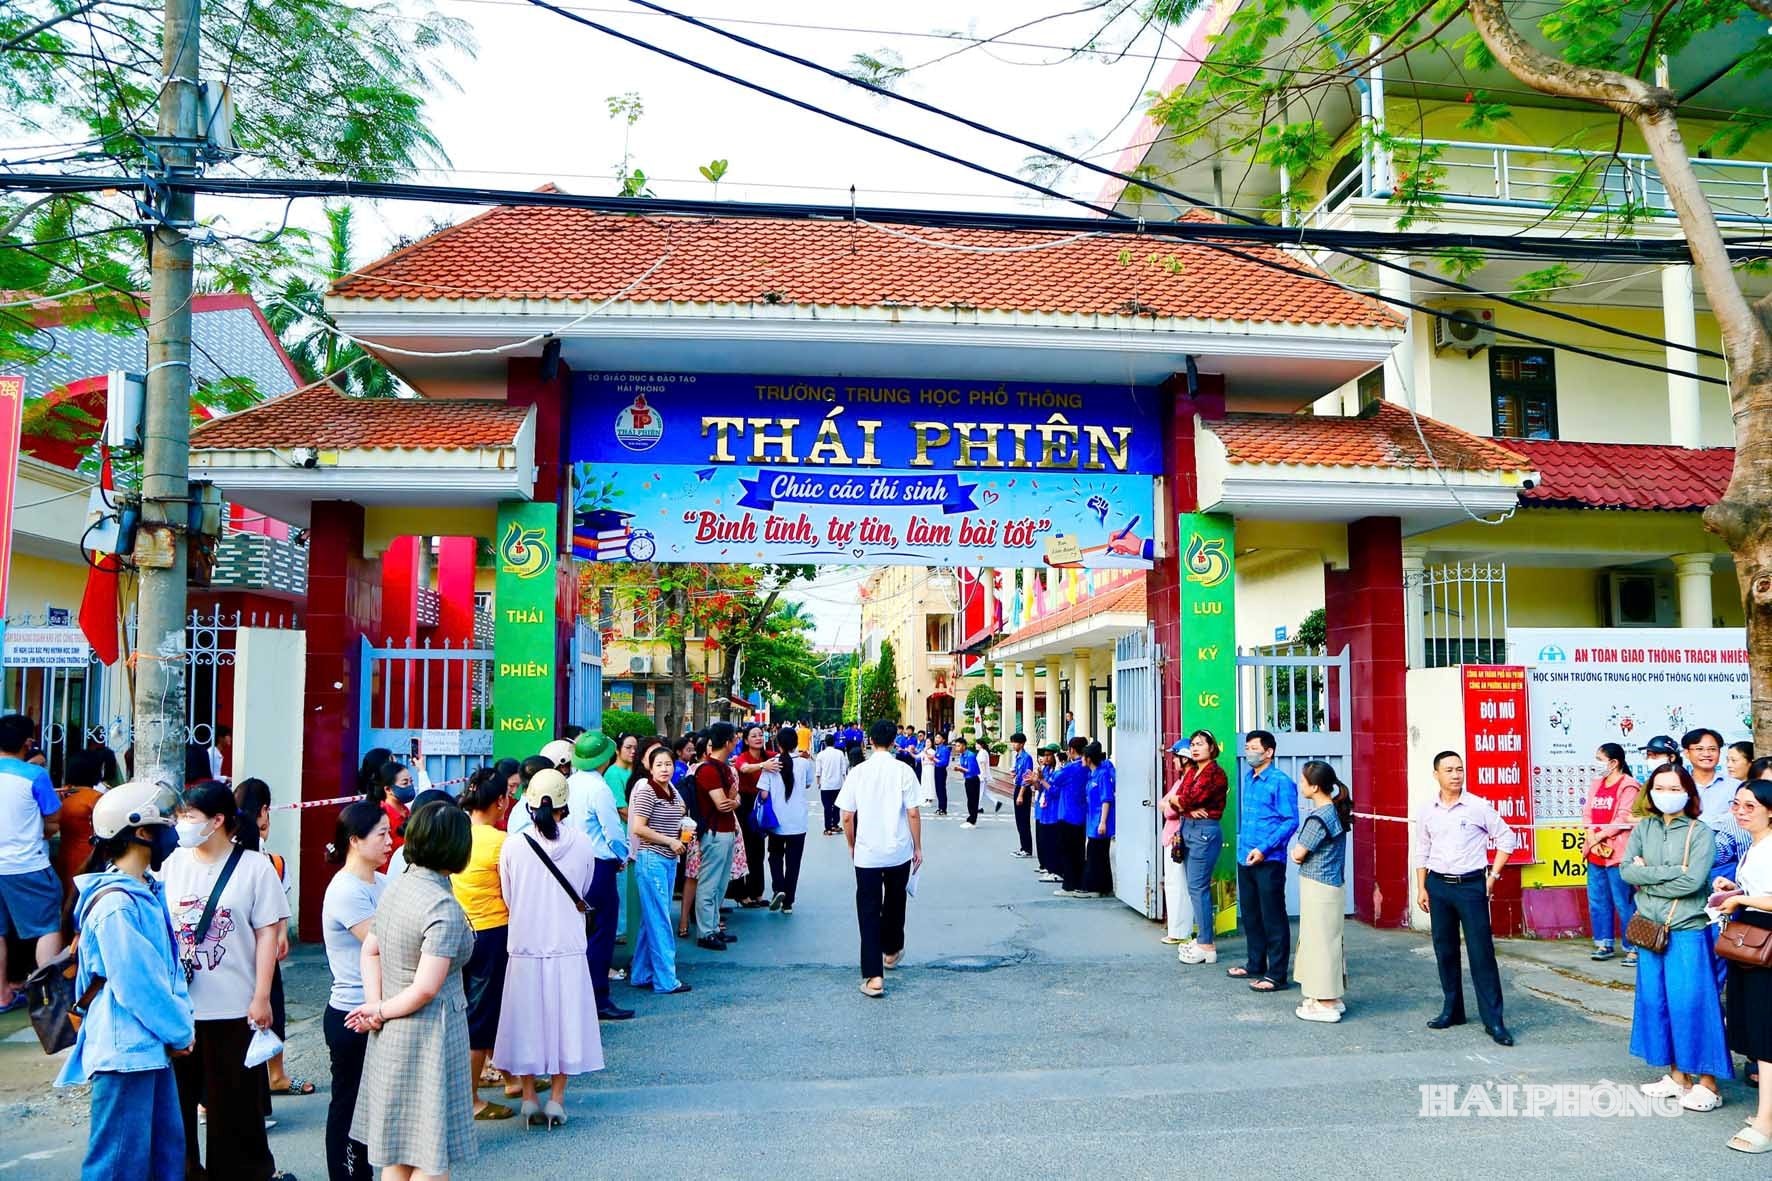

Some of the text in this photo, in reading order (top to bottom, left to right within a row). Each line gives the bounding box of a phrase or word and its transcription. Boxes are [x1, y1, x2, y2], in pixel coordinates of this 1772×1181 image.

[754, 382, 1082, 409] TRƯỜNG TRUNG HỌC PHỔ THÔNG
[701, 405, 1132, 471] THÁI PHIÊN
[769, 474, 949, 502] Chúc các thí sinh
[763, 512, 820, 546] tĩnh,
[826, 514, 854, 551] tự
[858, 515, 900, 547] tin,
[905, 515, 952, 548] làm
[957, 515, 996, 548] bài
[506, 606, 544, 623] THÁI
[1574, 648, 1588, 663] AN
[1621, 648, 1644, 664] GIAO
[1648, 647, 1681, 664] THÔNG
[500, 660, 548, 677] PHIÊN
[1533, 672, 1550, 684] HỌC
[1551, 672, 1569, 682] SINH
[1570, 671, 1602, 683] TRƯỜNG
[1604, 673, 1630, 683] TRUNG
[1631, 673, 1647, 684] HỌC
[1666, 672, 1691, 683] THÔNG
[1708, 672, 1735, 683] KHÔNG
[1480, 698, 1515, 723] ĐỘI MŨ
[500, 713, 546, 731] NGÀY
[1475, 727, 1522, 752] BẢO HIỂM
[1478, 767, 1495, 785] KHI
[1497, 796, 1514, 817] MÔ
